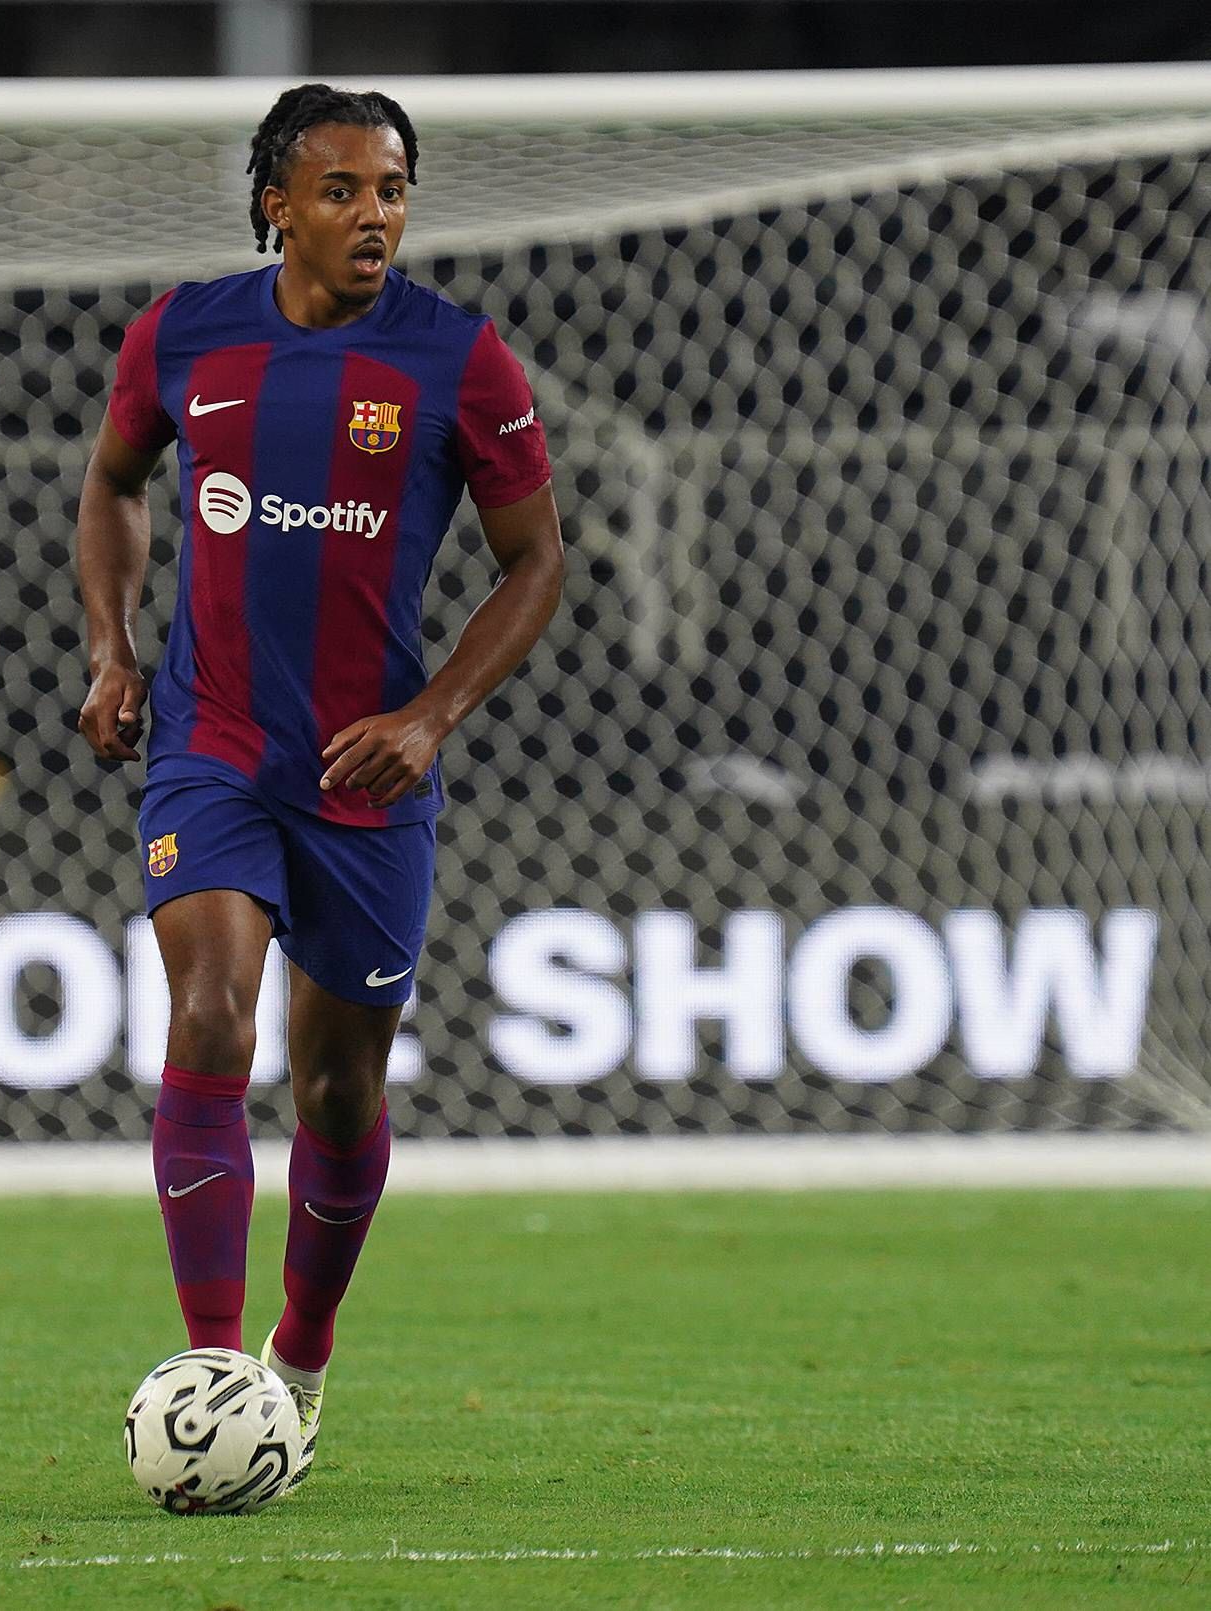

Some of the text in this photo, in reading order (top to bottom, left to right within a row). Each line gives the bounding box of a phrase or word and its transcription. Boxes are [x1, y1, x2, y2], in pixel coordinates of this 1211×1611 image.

[498, 406, 534, 435] AMBI
[259, 494, 388, 539] Spotify
[488, 906, 1157, 1084] SHOW
